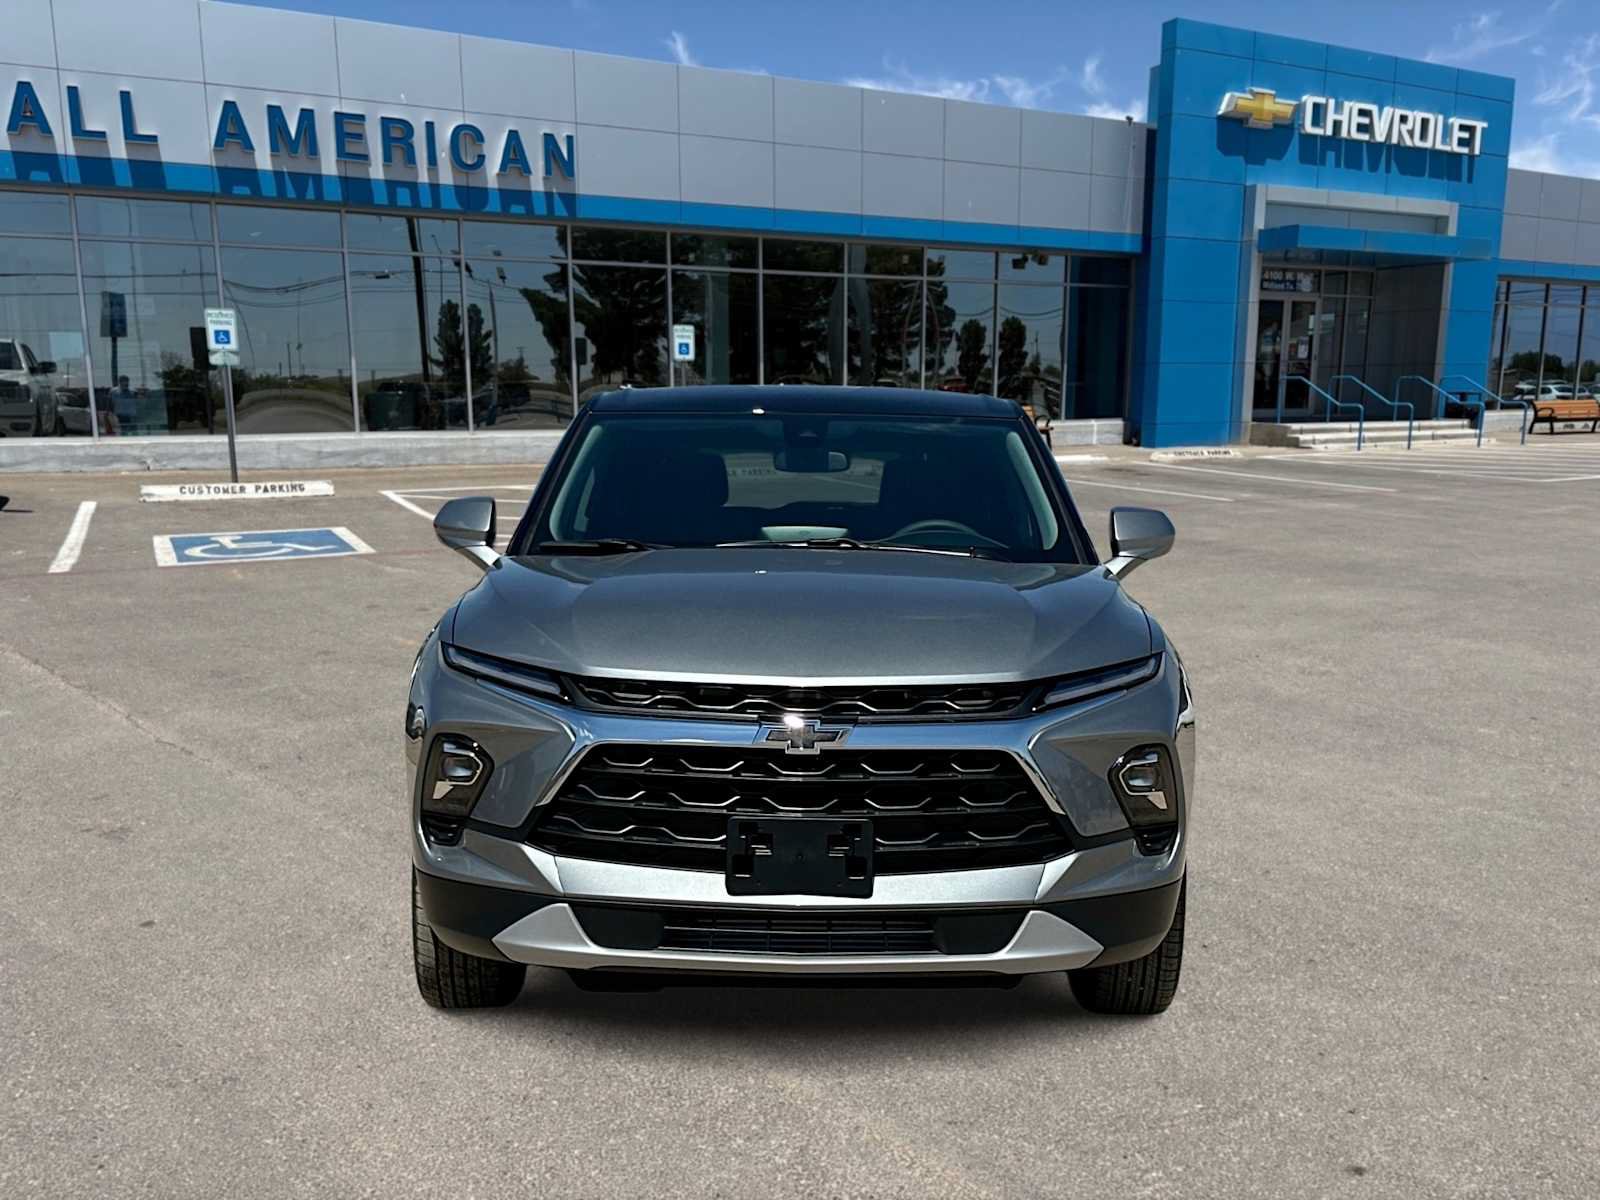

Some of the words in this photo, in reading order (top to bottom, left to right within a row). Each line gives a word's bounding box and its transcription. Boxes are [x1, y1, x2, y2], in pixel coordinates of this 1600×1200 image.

[7, 81, 159, 143] ALL
[213, 100, 576, 179] AMERICAN
[1301, 94, 1488, 155] CHEVROLET
[179, 486, 247, 495] CUSTOMER
[255, 483, 305, 493] PARKING
